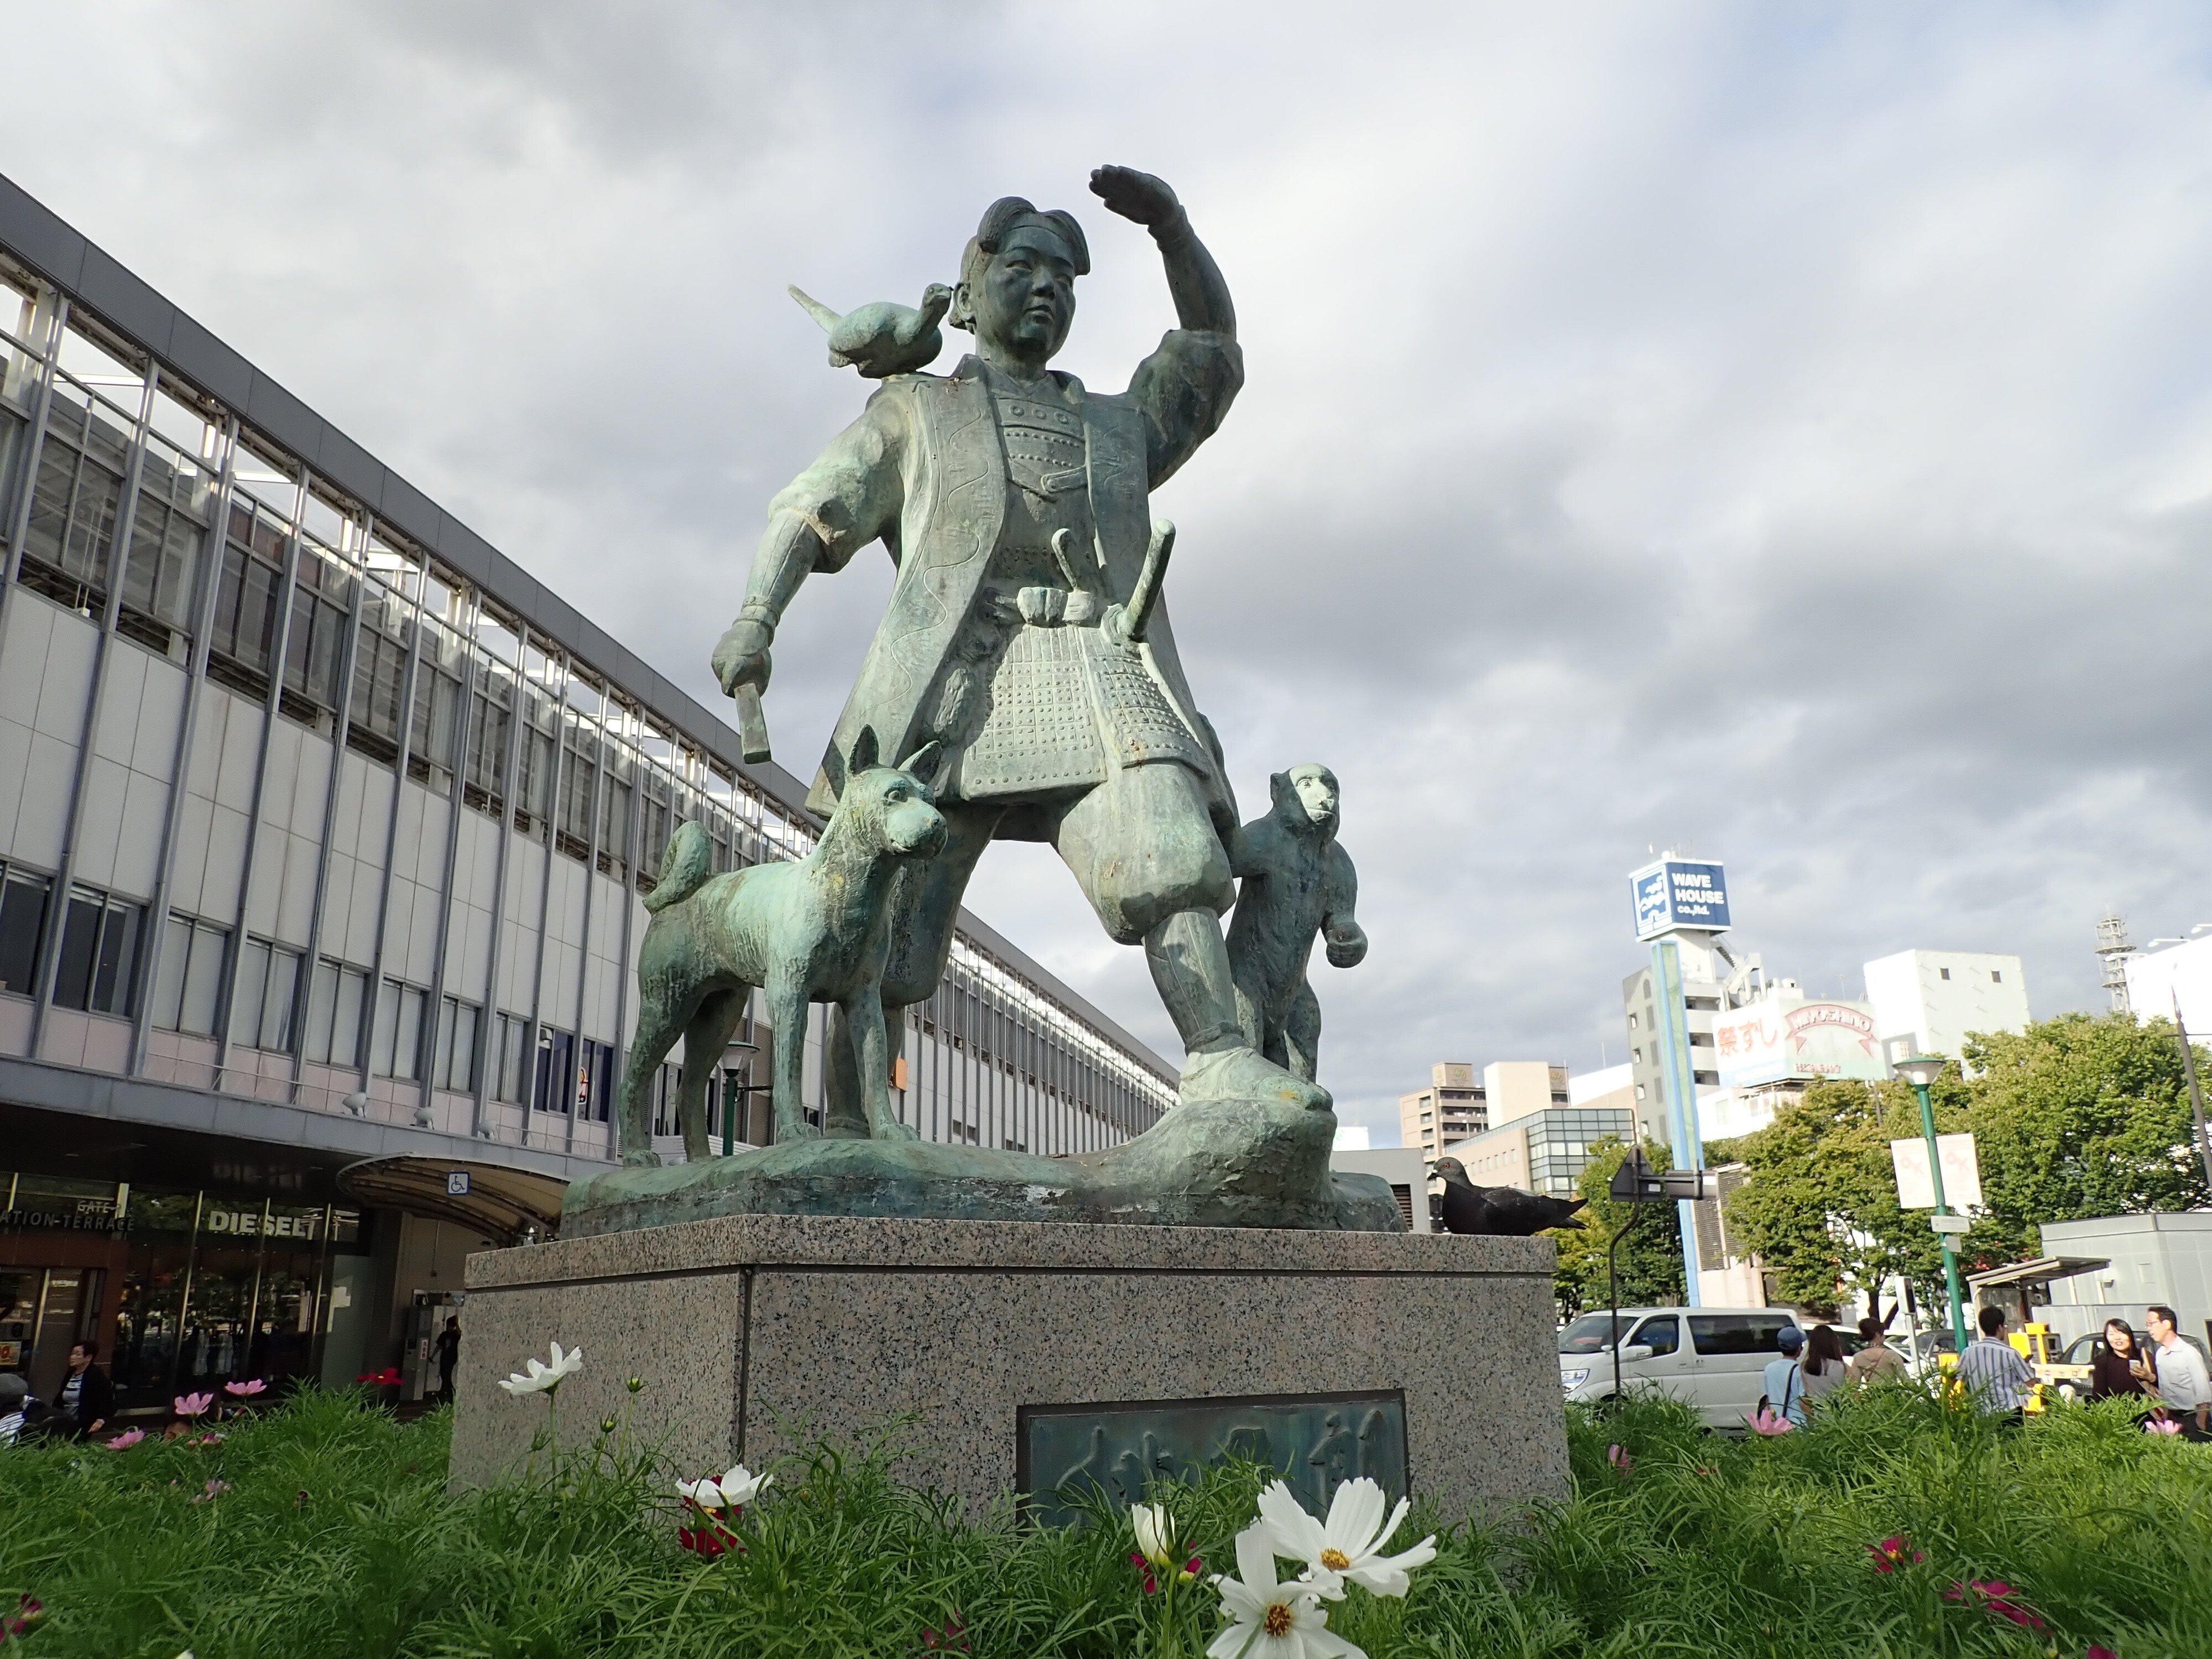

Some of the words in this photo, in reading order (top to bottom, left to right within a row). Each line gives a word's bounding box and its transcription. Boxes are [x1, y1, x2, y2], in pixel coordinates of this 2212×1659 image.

[1672, 873, 1712, 888] WAVE
[1675, 889, 1724, 904] HOUSE
[1717, 1018, 1778, 1057] 祭ずし
[208, 1210, 306, 1237] DIESEL
